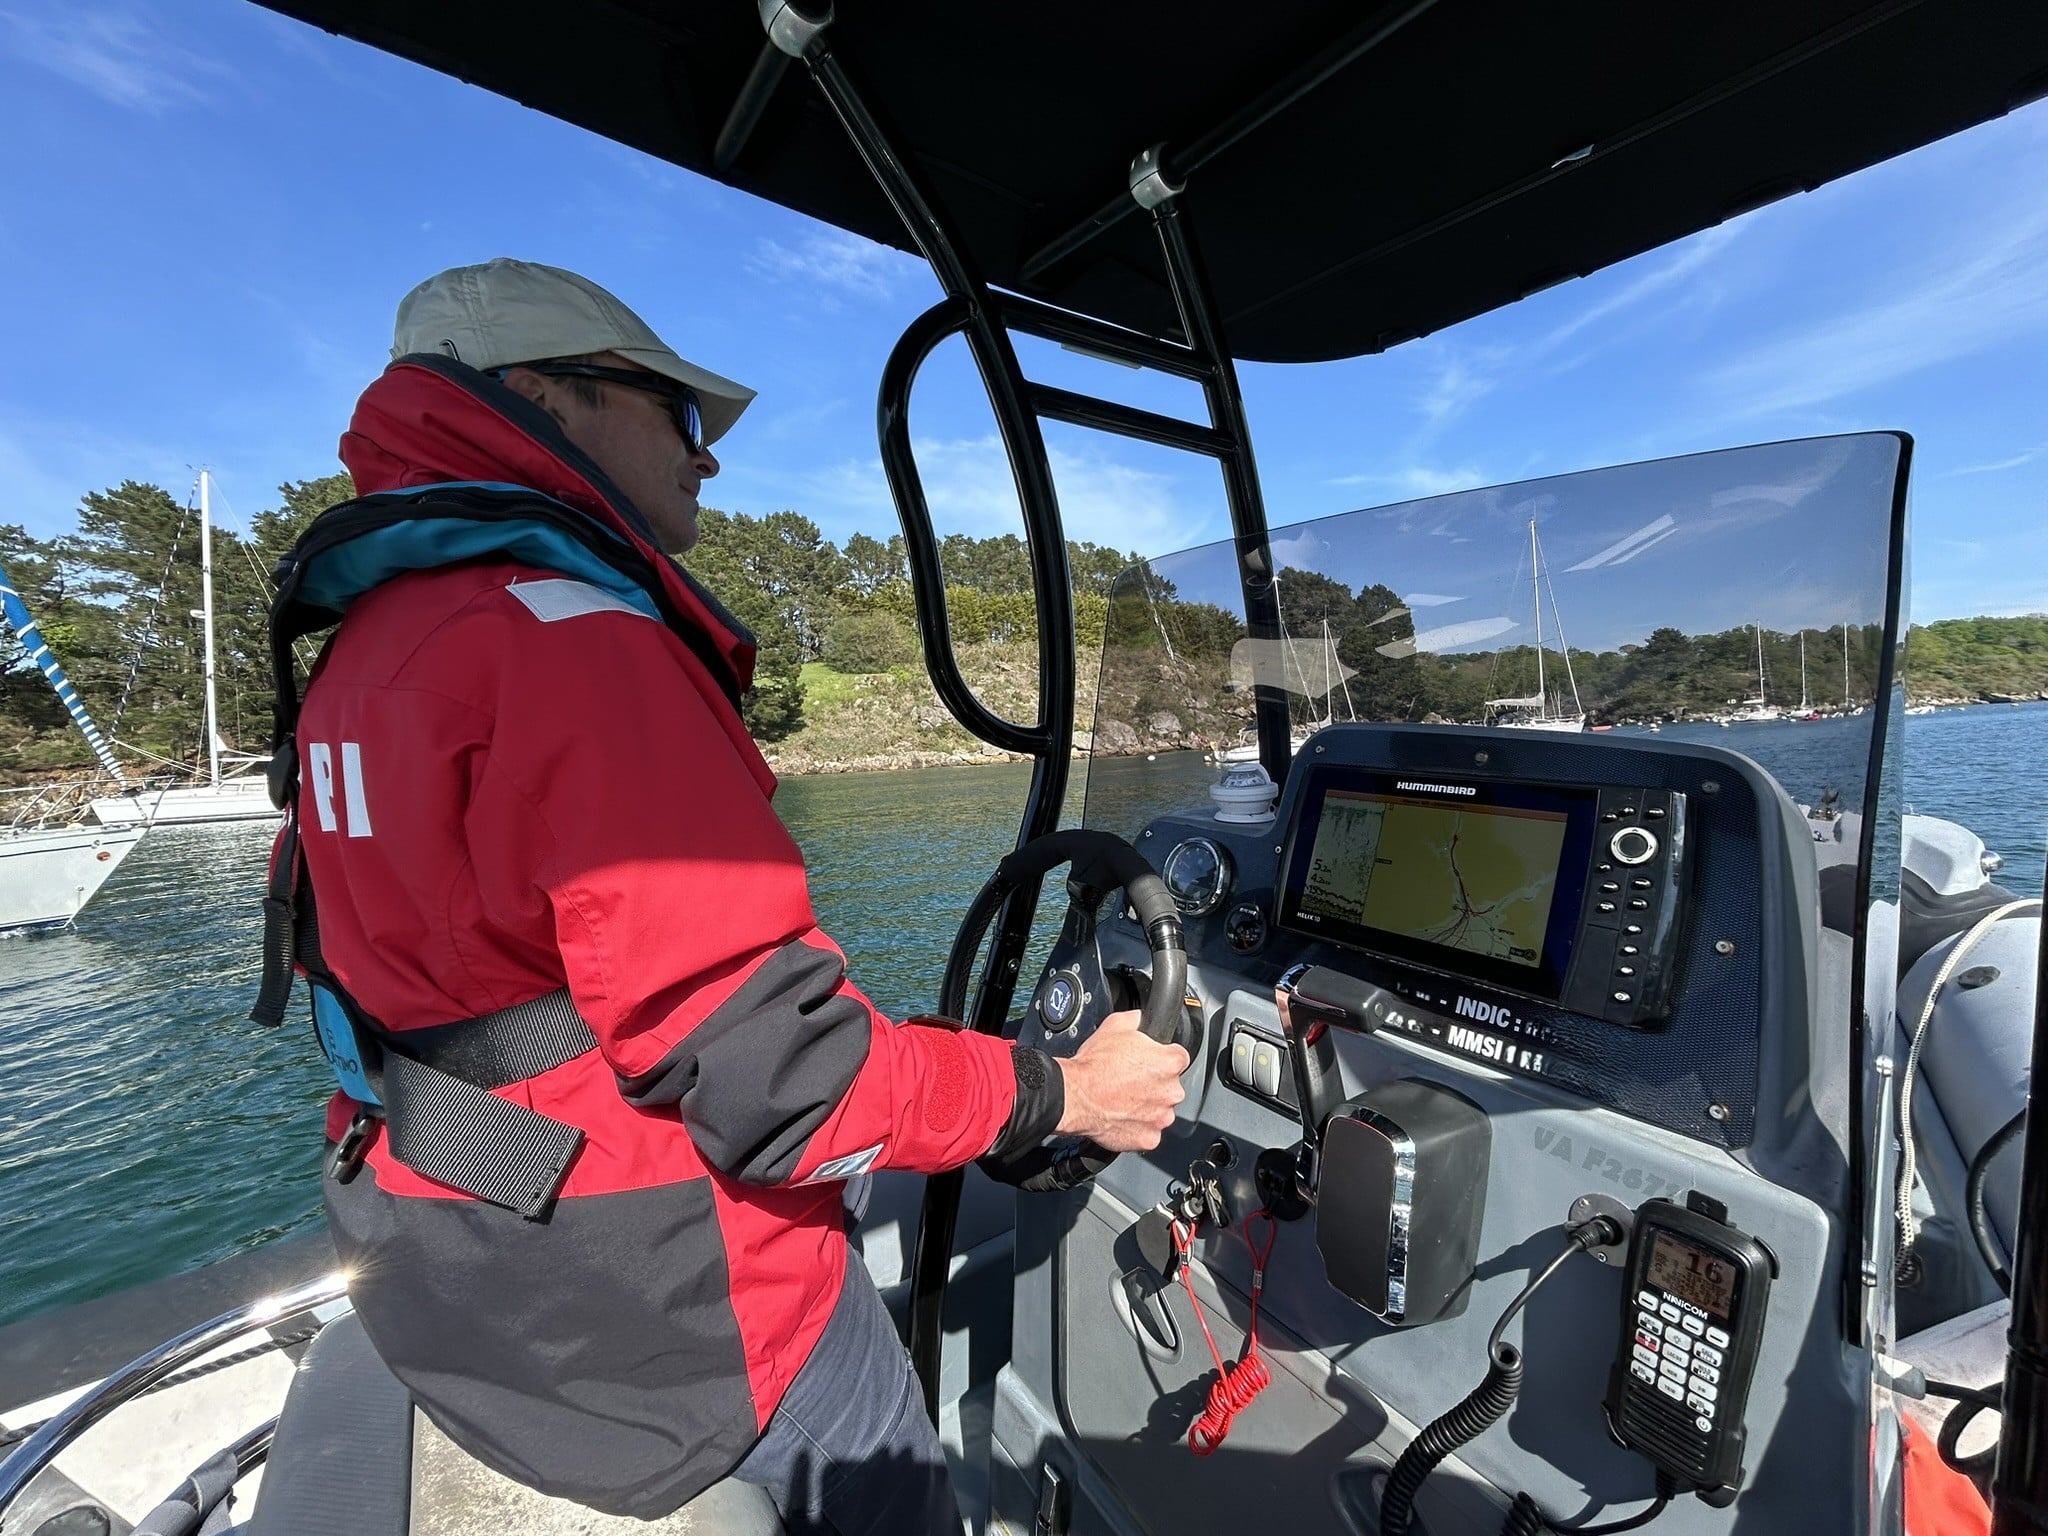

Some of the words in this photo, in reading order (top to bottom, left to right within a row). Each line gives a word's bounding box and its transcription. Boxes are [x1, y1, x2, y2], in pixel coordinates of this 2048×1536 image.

[1396, 781, 1477, 796] HUMMINBIRD
[1296, 911, 1314, 921] HELIX
[1454, 995, 1512, 1029] INDIC
[1447, 1024, 1504, 1062] MMSI
[1534, 1125, 1573, 1164] VA
[1686, 1251, 1723, 1285] 16
